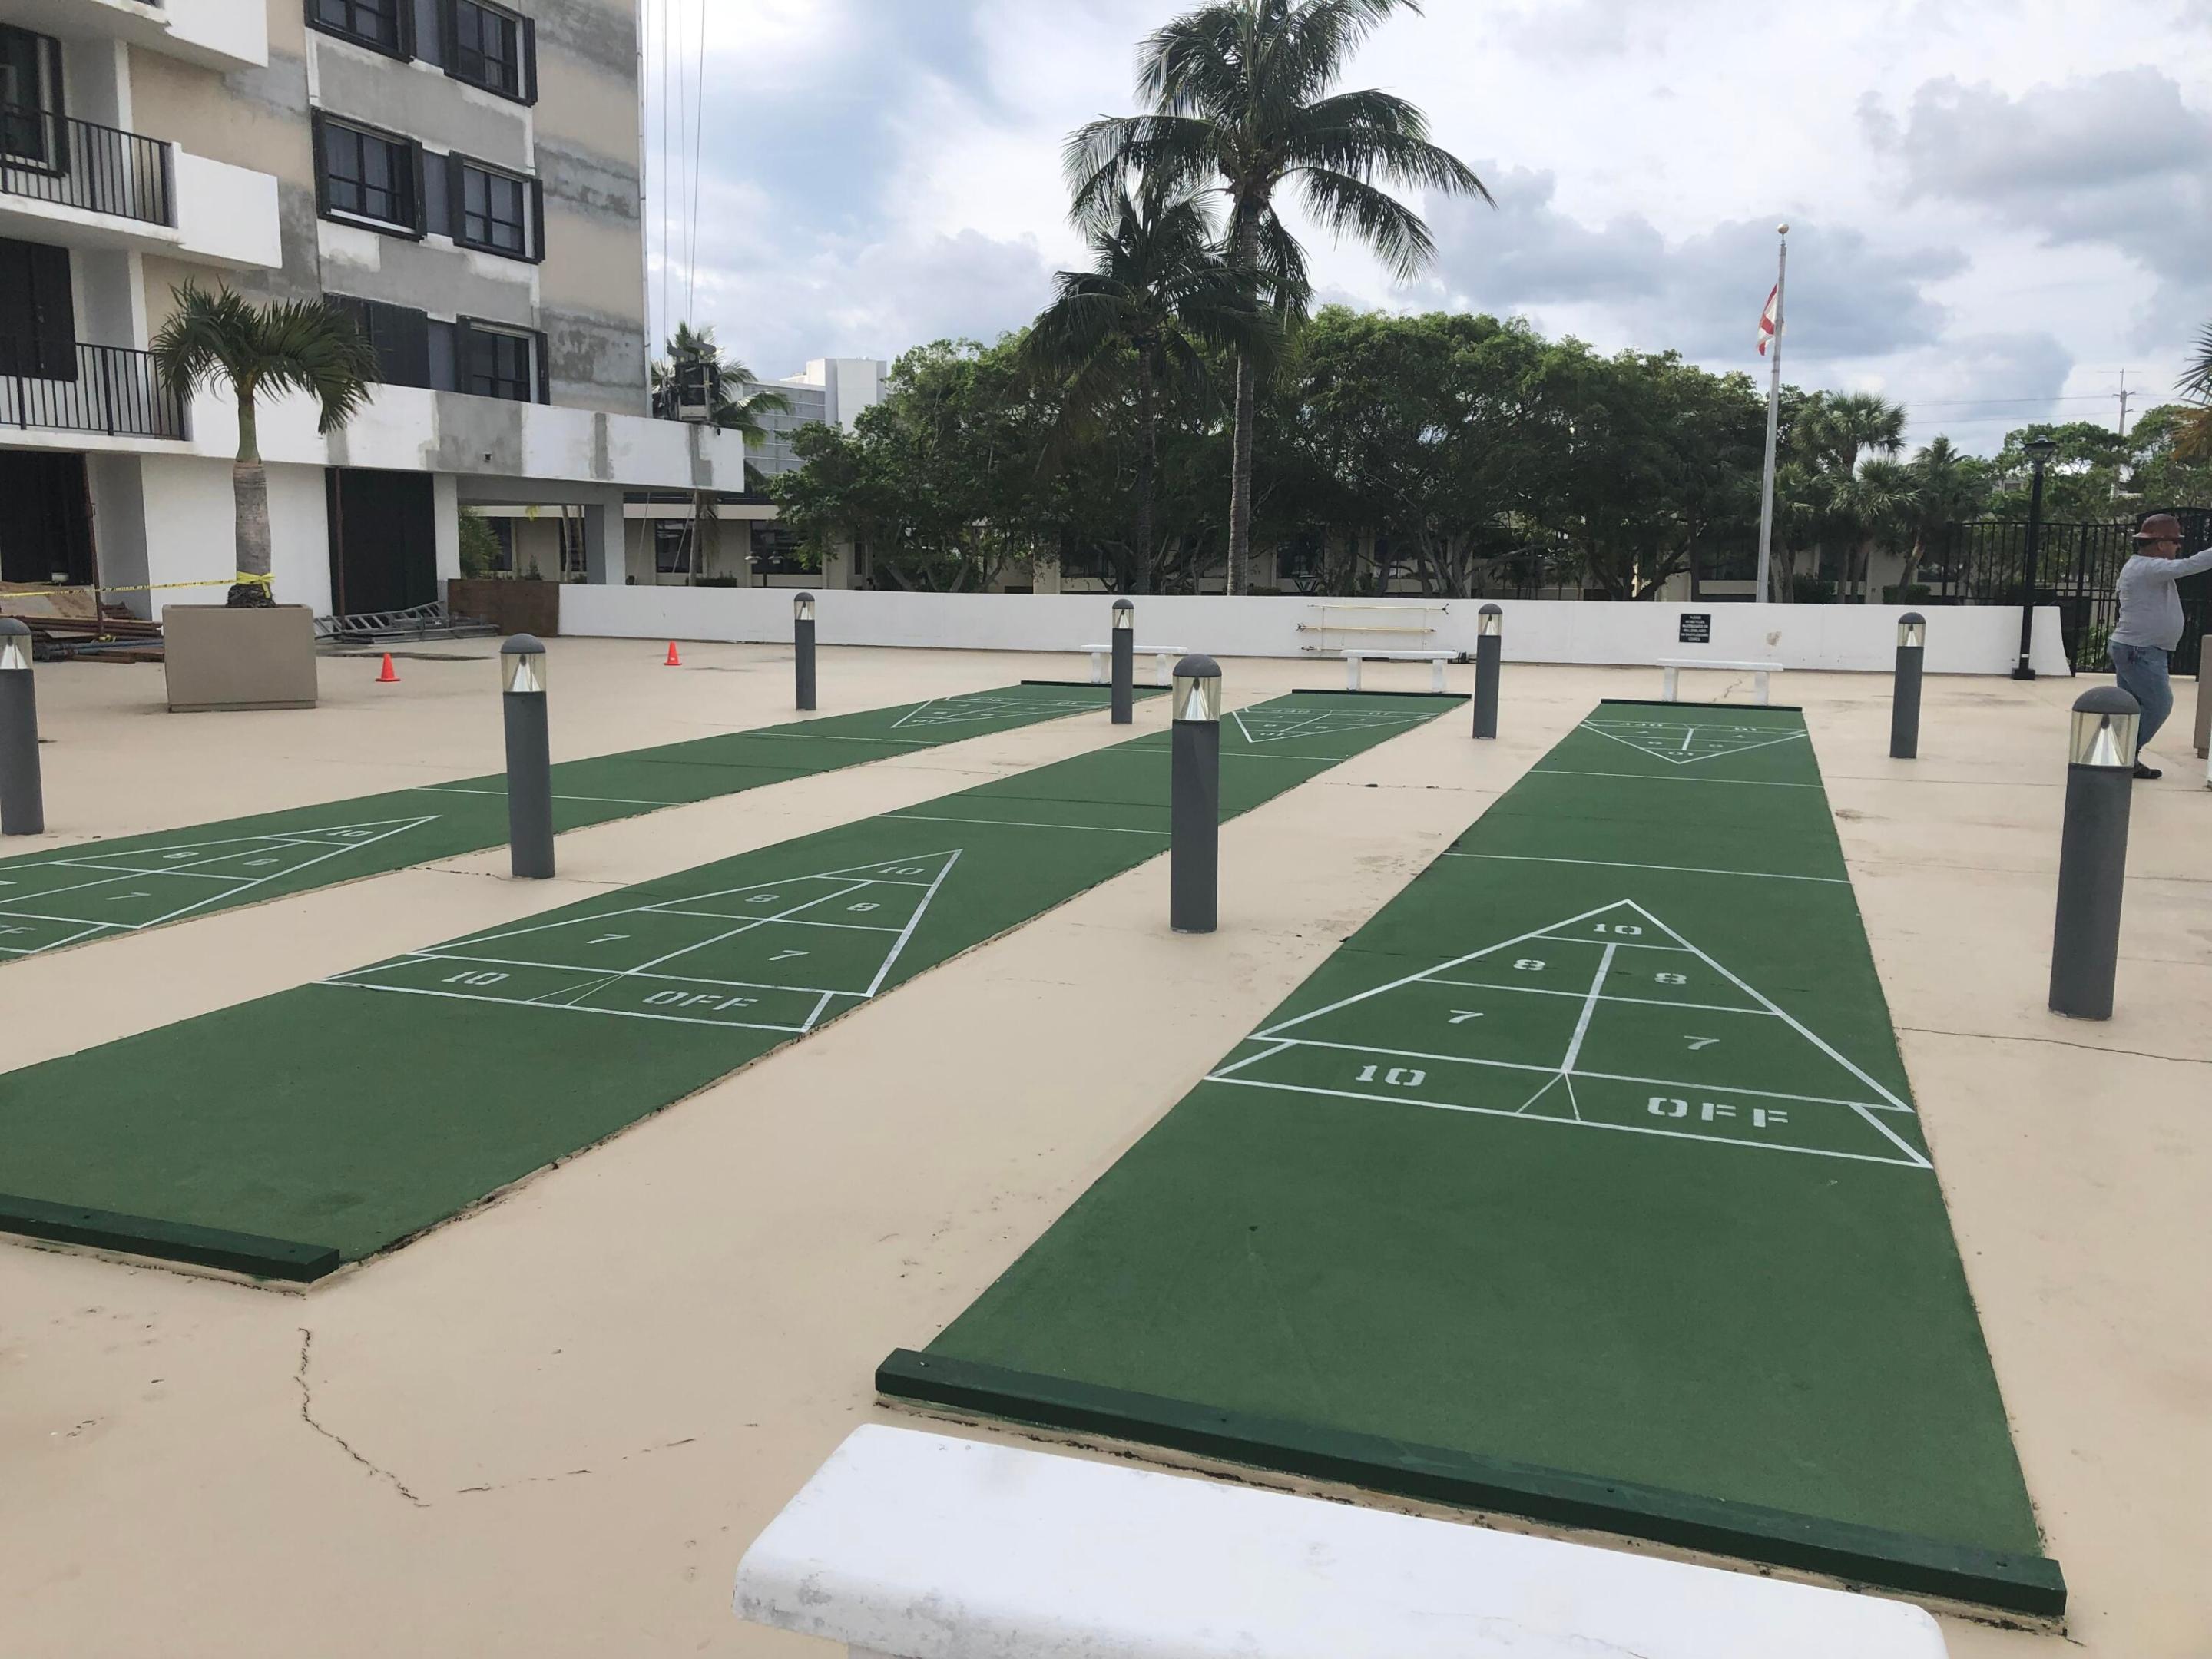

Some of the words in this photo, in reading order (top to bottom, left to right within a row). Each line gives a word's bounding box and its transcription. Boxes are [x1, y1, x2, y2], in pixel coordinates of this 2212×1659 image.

[327, 829, 373, 838] 10
[162, 851, 200, 859] 8
[242, 857, 279, 866] 8
[876, 866, 925, 876] 10
[106, 892, 151, 900] 7
[745, 894, 780, 902] 8
[846, 902, 881, 912] 8
[1593, 923, 1642, 935] 10
[586, 933, 630, 944] 7
[768, 949, 810, 961] 7
[1513, 959, 1546, 971] 8
[441, 970, 510, 985] 10
[1654, 972, 1687, 985] 8
[642, 990, 760, 1011] OFF
[1448, 1009, 1484, 1024] 7
[1684, 1035, 1720, 1050] 7
[1355, 1065, 1426, 1087] 10
[1647, 1096, 1789, 1129] OFF
